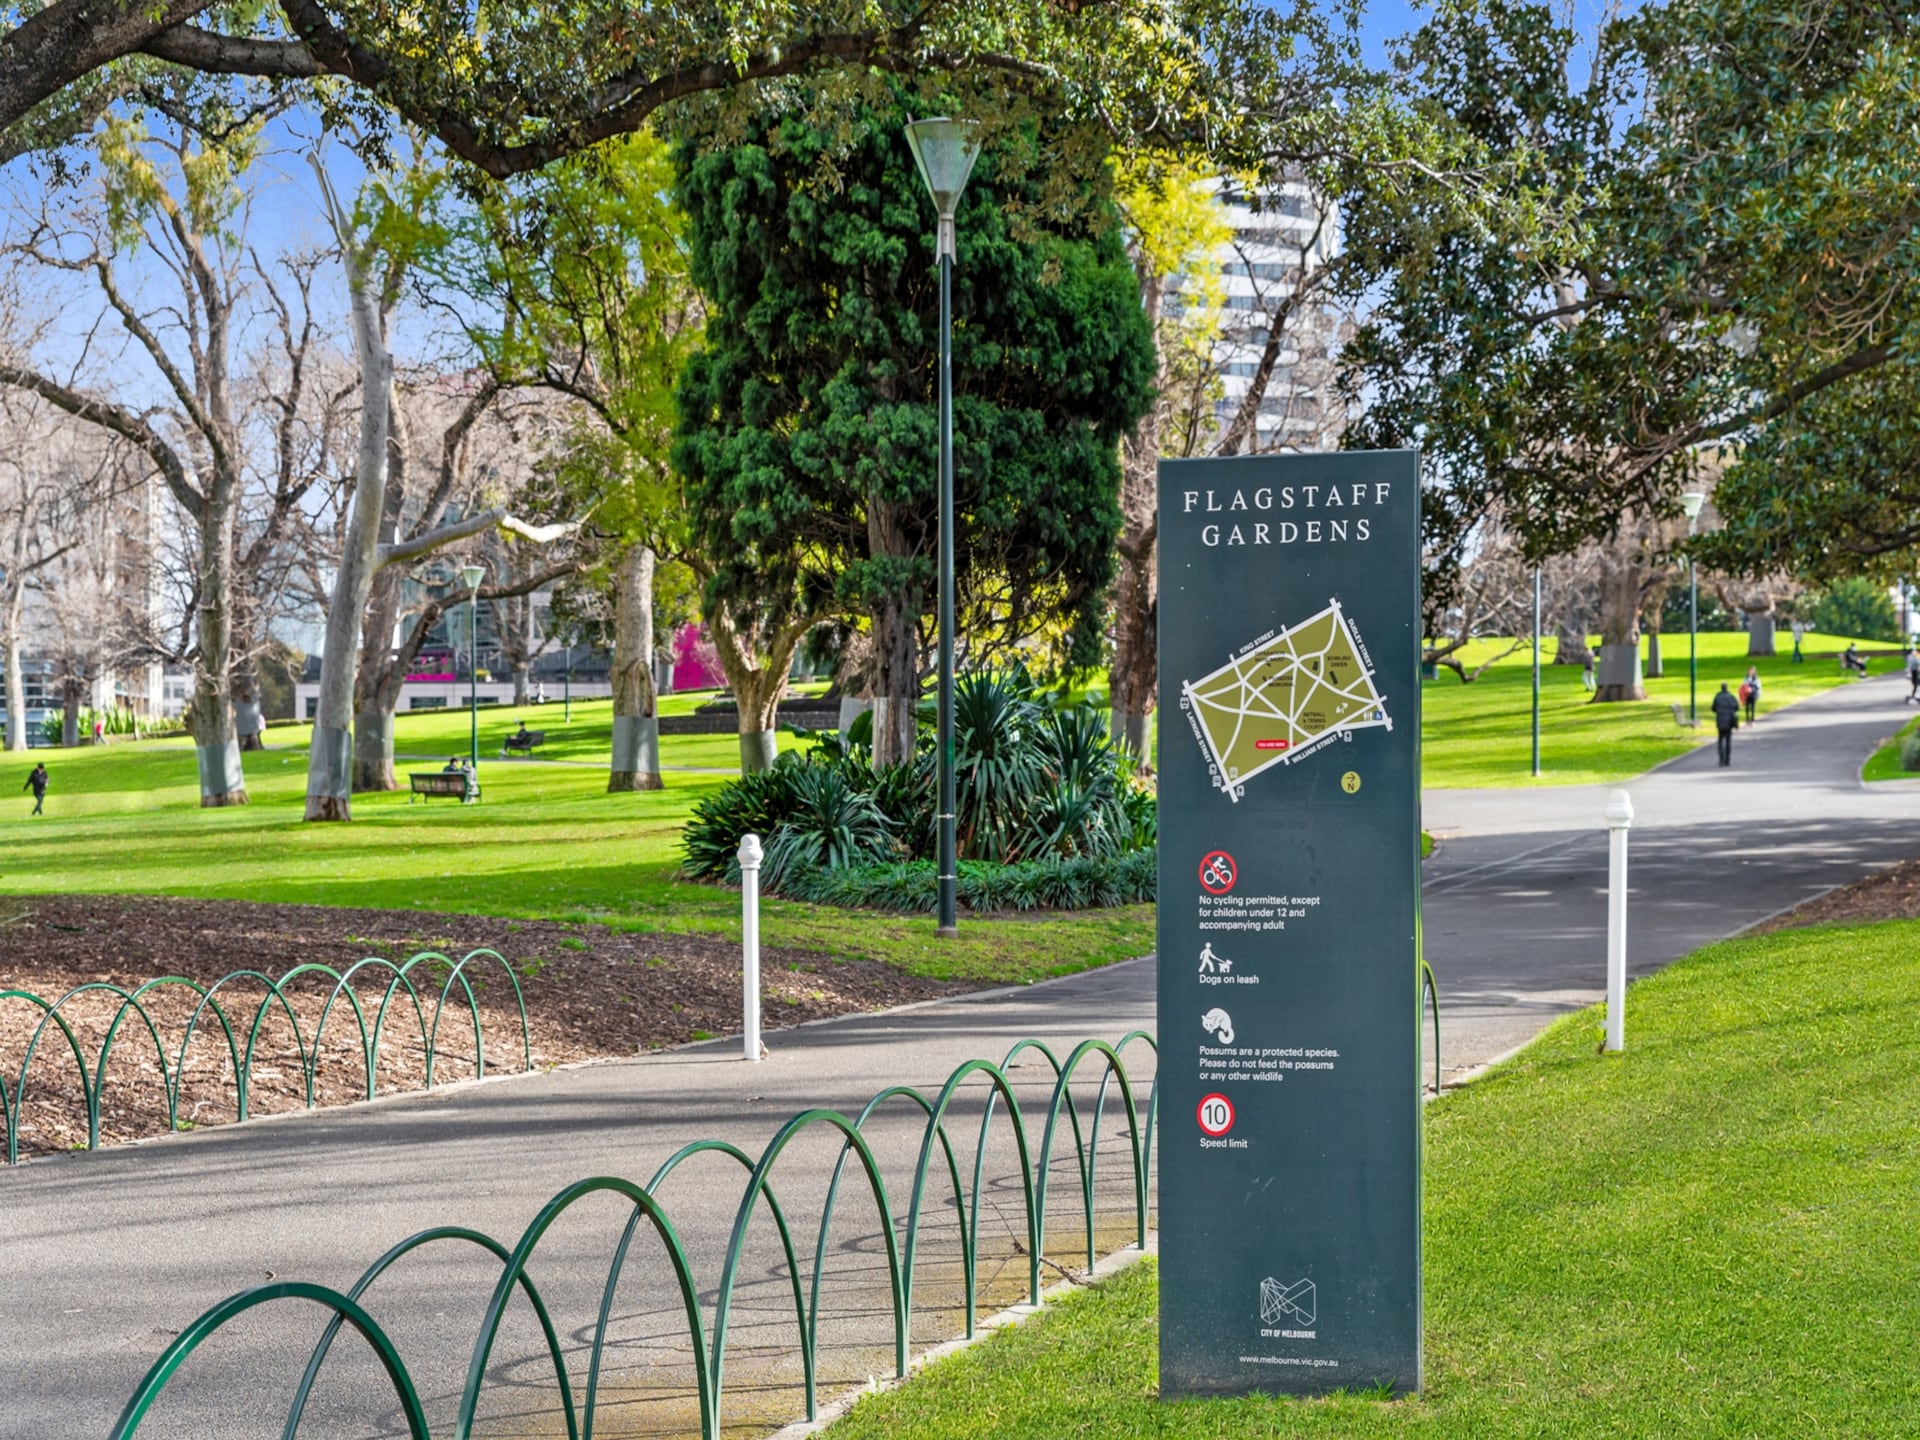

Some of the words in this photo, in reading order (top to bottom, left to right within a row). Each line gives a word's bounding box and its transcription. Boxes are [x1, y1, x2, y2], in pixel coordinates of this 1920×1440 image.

[1183, 483, 1391, 512] FLAGSTAFF
[1202, 519, 1370, 546] GARDENS
[1240, 641, 1254, 654] KING
[1254, 630, 1274, 646] STREET
[1359, 643, 1373, 667] STREET
[1199, 740, 1212, 763] STREET
[1292, 746, 1316, 763] WILLIAM
[1316, 734, 1337, 750] STREET
[1199, 896, 1211, 904] No
[1214, 896, 1243, 906] cycling
[1246, 896, 1289, 906] permitted,
[1291, 896, 1320, 906] except
[1199, 908, 1210, 917] for
[1213, 908, 1247, 917] children
[1250, 908, 1274, 917] under
[1289, 908, 1305, 917] and
[1199, 921, 1261, 931] accompanying
[1263, 921, 1284, 929] adult
[1199, 975, 1221, 985] Dogs
[1237, 975, 1259, 984] leash
[1199, 1046, 1237, 1055] Possums
[1262, 1048, 1303, 1057] protected
[1305, 1048, 1340, 1057] species.
[1199, 1058, 1226, 1067] Please
[1229, 1059, 1240, 1068] do
[1258, 1060, 1276, 1068] feed
[1279, 1060, 1293, 1068] the
[1210, 1073, 1225, 1082] any
[1253, 1072, 1283, 1081] wildlife
[1205, 1104, 1226, 1125] 10
[1200, 1138, 1226, 1148] Speed
[1229, 1139, 1248, 1148] limit
[1282, 1330, 1316, 1338] MELBOURNE
[1239, 1356, 1338, 1367] www.melbourne.vic.gov.au
